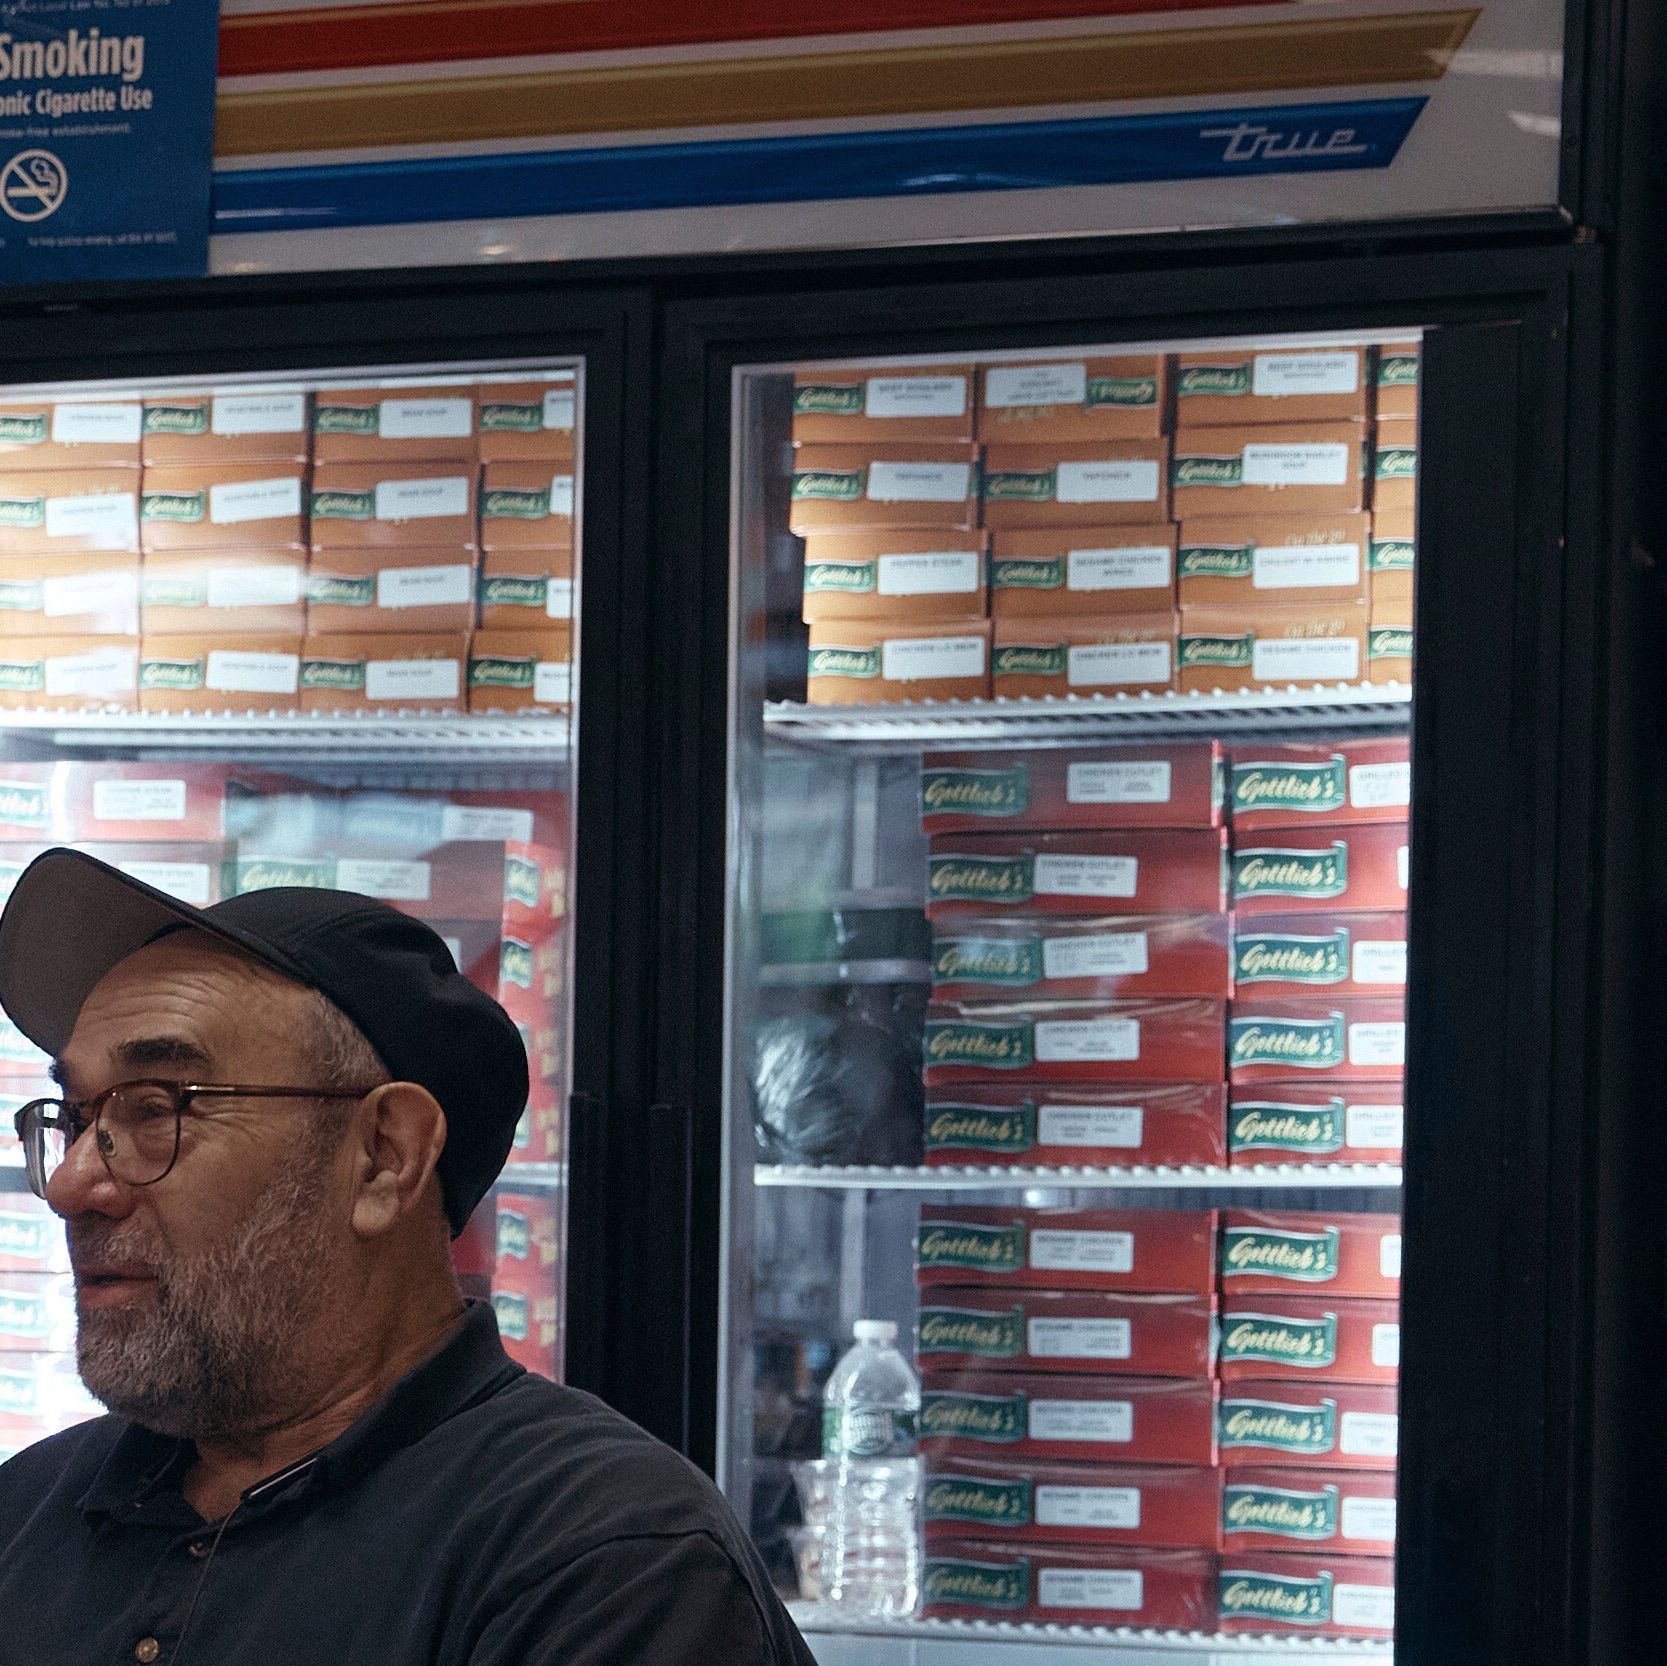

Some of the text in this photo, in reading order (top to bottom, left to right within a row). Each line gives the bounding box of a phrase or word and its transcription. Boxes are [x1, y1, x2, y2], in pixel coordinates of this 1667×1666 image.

[34, 87, 117, 118] Cigarette
[119, 84, 154, 111] Use
[1199, 122, 1368, 162] true
[924, 776, 1016, 806] Gottlieb's
[1236, 771, 1335, 804] Gottlieb's
[931, 862, 1024, 893] Gottlieb's
[1237, 857, 1336, 889] Gottlieb's
[1239, 942, 1338, 975] Gottlieb's
[928, 1028, 1023, 1058] Gottlieb's
[1234, 1026, 1334, 1058] Gottlieb's
[929, 1111, 1023, 1142] Gottlieb's
[1234, 1111, 1334, 1143] Gottlieb's
[921, 1230, 1014, 1261] Gottlieb's
[1228, 1236, 1327, 1270] Gottlieb's
[921, 1316, 1014, 1345] Gottlieb's
[1227, 1322, 1326, 1357] Gottlieb's
[923, 1401, 1015, 1431] Gottlieb's
[1227, 1408, 1324, 1443] Gottlieb's
[1228, 1494, 1327, 1529] Gottlieb's
[1222, 1580, 1321, 1615] Gottlieb's
